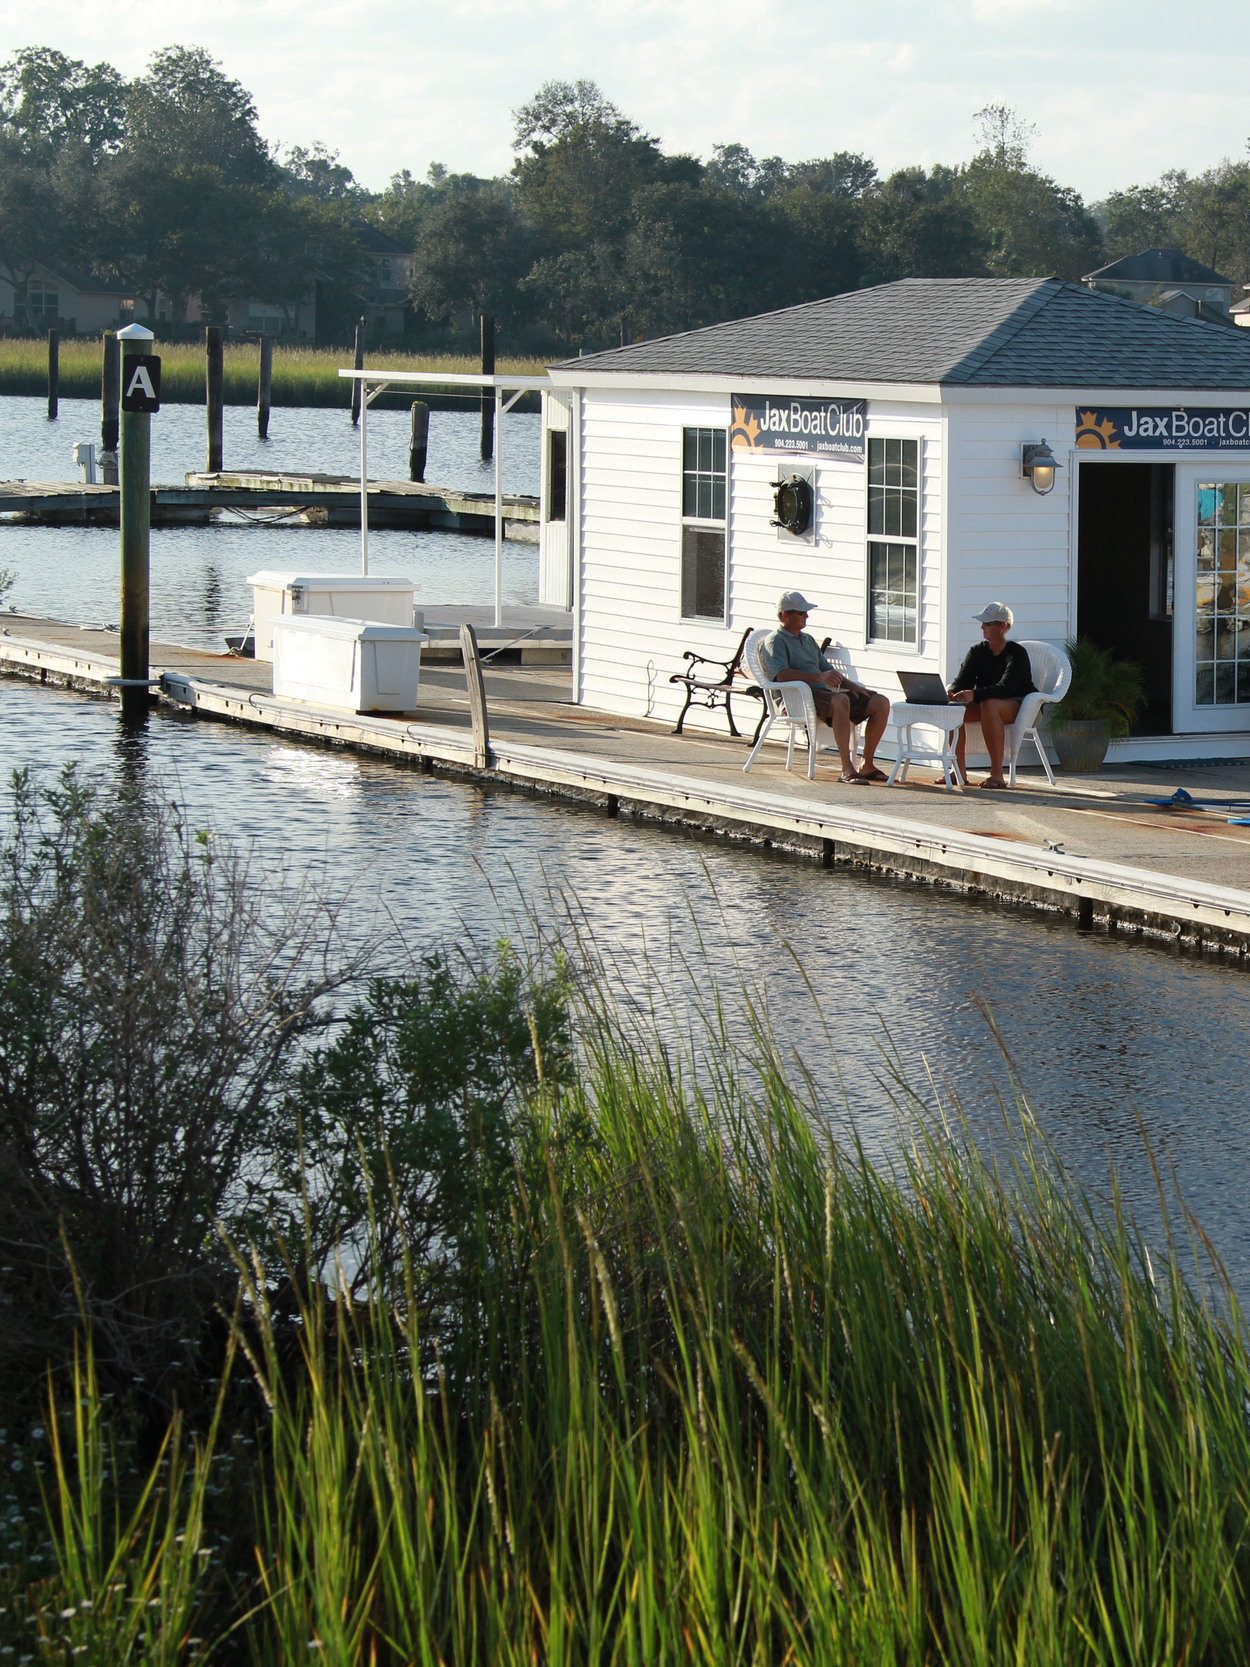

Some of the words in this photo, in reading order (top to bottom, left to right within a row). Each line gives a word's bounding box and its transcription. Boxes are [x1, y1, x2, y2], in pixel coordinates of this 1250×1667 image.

[126, 366, 156, 398] A
[774, 438, 809, 450] 904.223.5001
[816, 441, 863, 453] jaxboatclub.com
[1162, 438, 1208, 447] 904.223.5001
